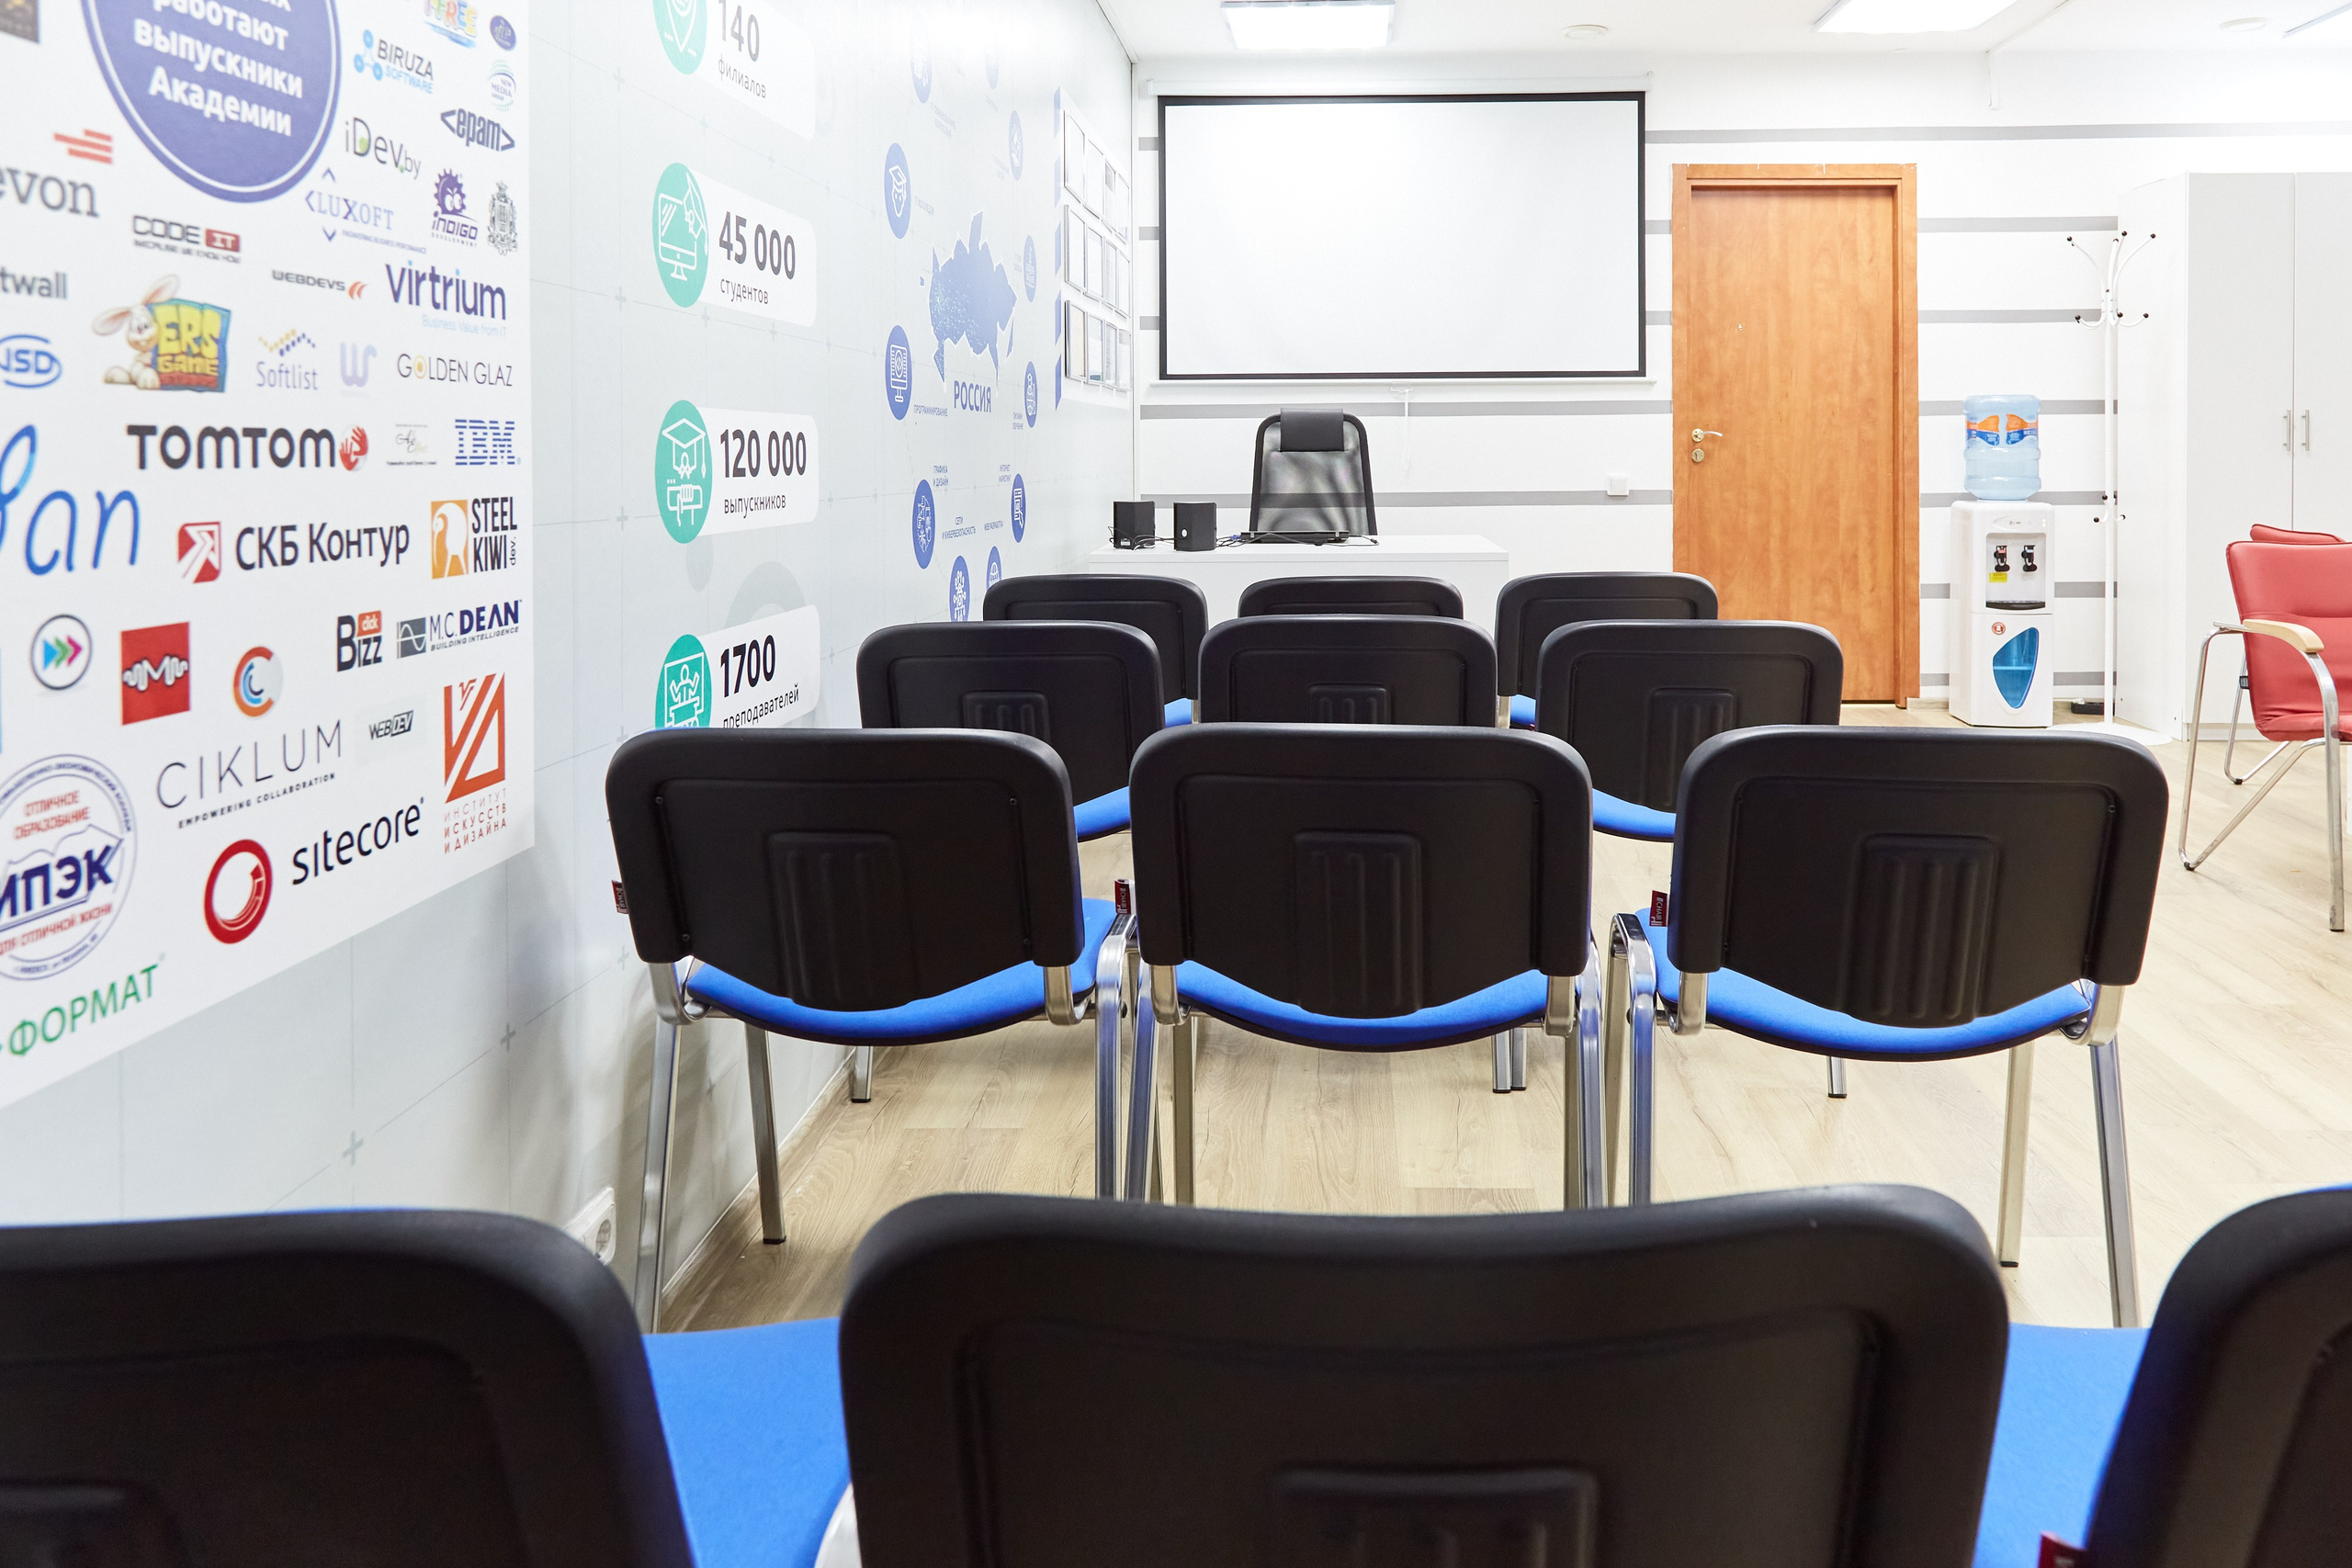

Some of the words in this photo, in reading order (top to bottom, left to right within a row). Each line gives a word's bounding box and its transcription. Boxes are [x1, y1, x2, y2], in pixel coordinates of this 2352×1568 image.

[718, 0, 760, 62] 140
[133, 17, 303, 99] выпускники
[378, 39, 434, 81] BIRUZA
[385, 65, 434, 95] SOFTWARE
[718, 53, 766, 99] филиалов
[148, 65, 292, 137] Академии
[0, 166, 99, 219] von
[315, 191, 395, 231] LUXOFT
[132, 214, 201, 245] CODE
[211, 231, 236, 250] IT
[718, 211, 747, 265] 45
[754, 223, 797, 280] 000
[719, 278, 769, 305] студентов
[153, 304, 221, 359] ERS
[256, 360, 319, 390] Softlist
[397, 353, 469, 383] GOLDEN
[473, 362, 513, 387] GLAZ
[954, 379, 992, 412] РОССИЯ
[126, 424, 336, 469] TOMTOM
[455, 419, 515, 467] IBM
[719, 429, 761, 478] 120
[767, 430, 807, 477] 000
[471, 496, 518, 535] STEEL
[724, 494, 786, 519] выпускников
[235, 524, 300, 571] СКБ
[309, 522, 410, 568] Контур
[473, 534, 507, 573] KIWI
[431, 637, 468, 652] BUILDING
[468, 626, 520, 643] INTELLIGENCE
[719, 634, 776, 698] 1700
[723, 682, 799, 729] преподавателей
[157, 719, 343, 808] CIKLUM
[178, 798, 253, 829] EMPOWERING
[256, 772, 336, 805] COLLABORATION
[444, 787, 507, 822] ИНСТИТУТ
[444, 802, 507, 840] ИСКУССТВ
[292, 804, 421, 886] sitecore
[444, 841, 450, 854] И
[454, 821, 507, 852] ДИЗАЙНА
